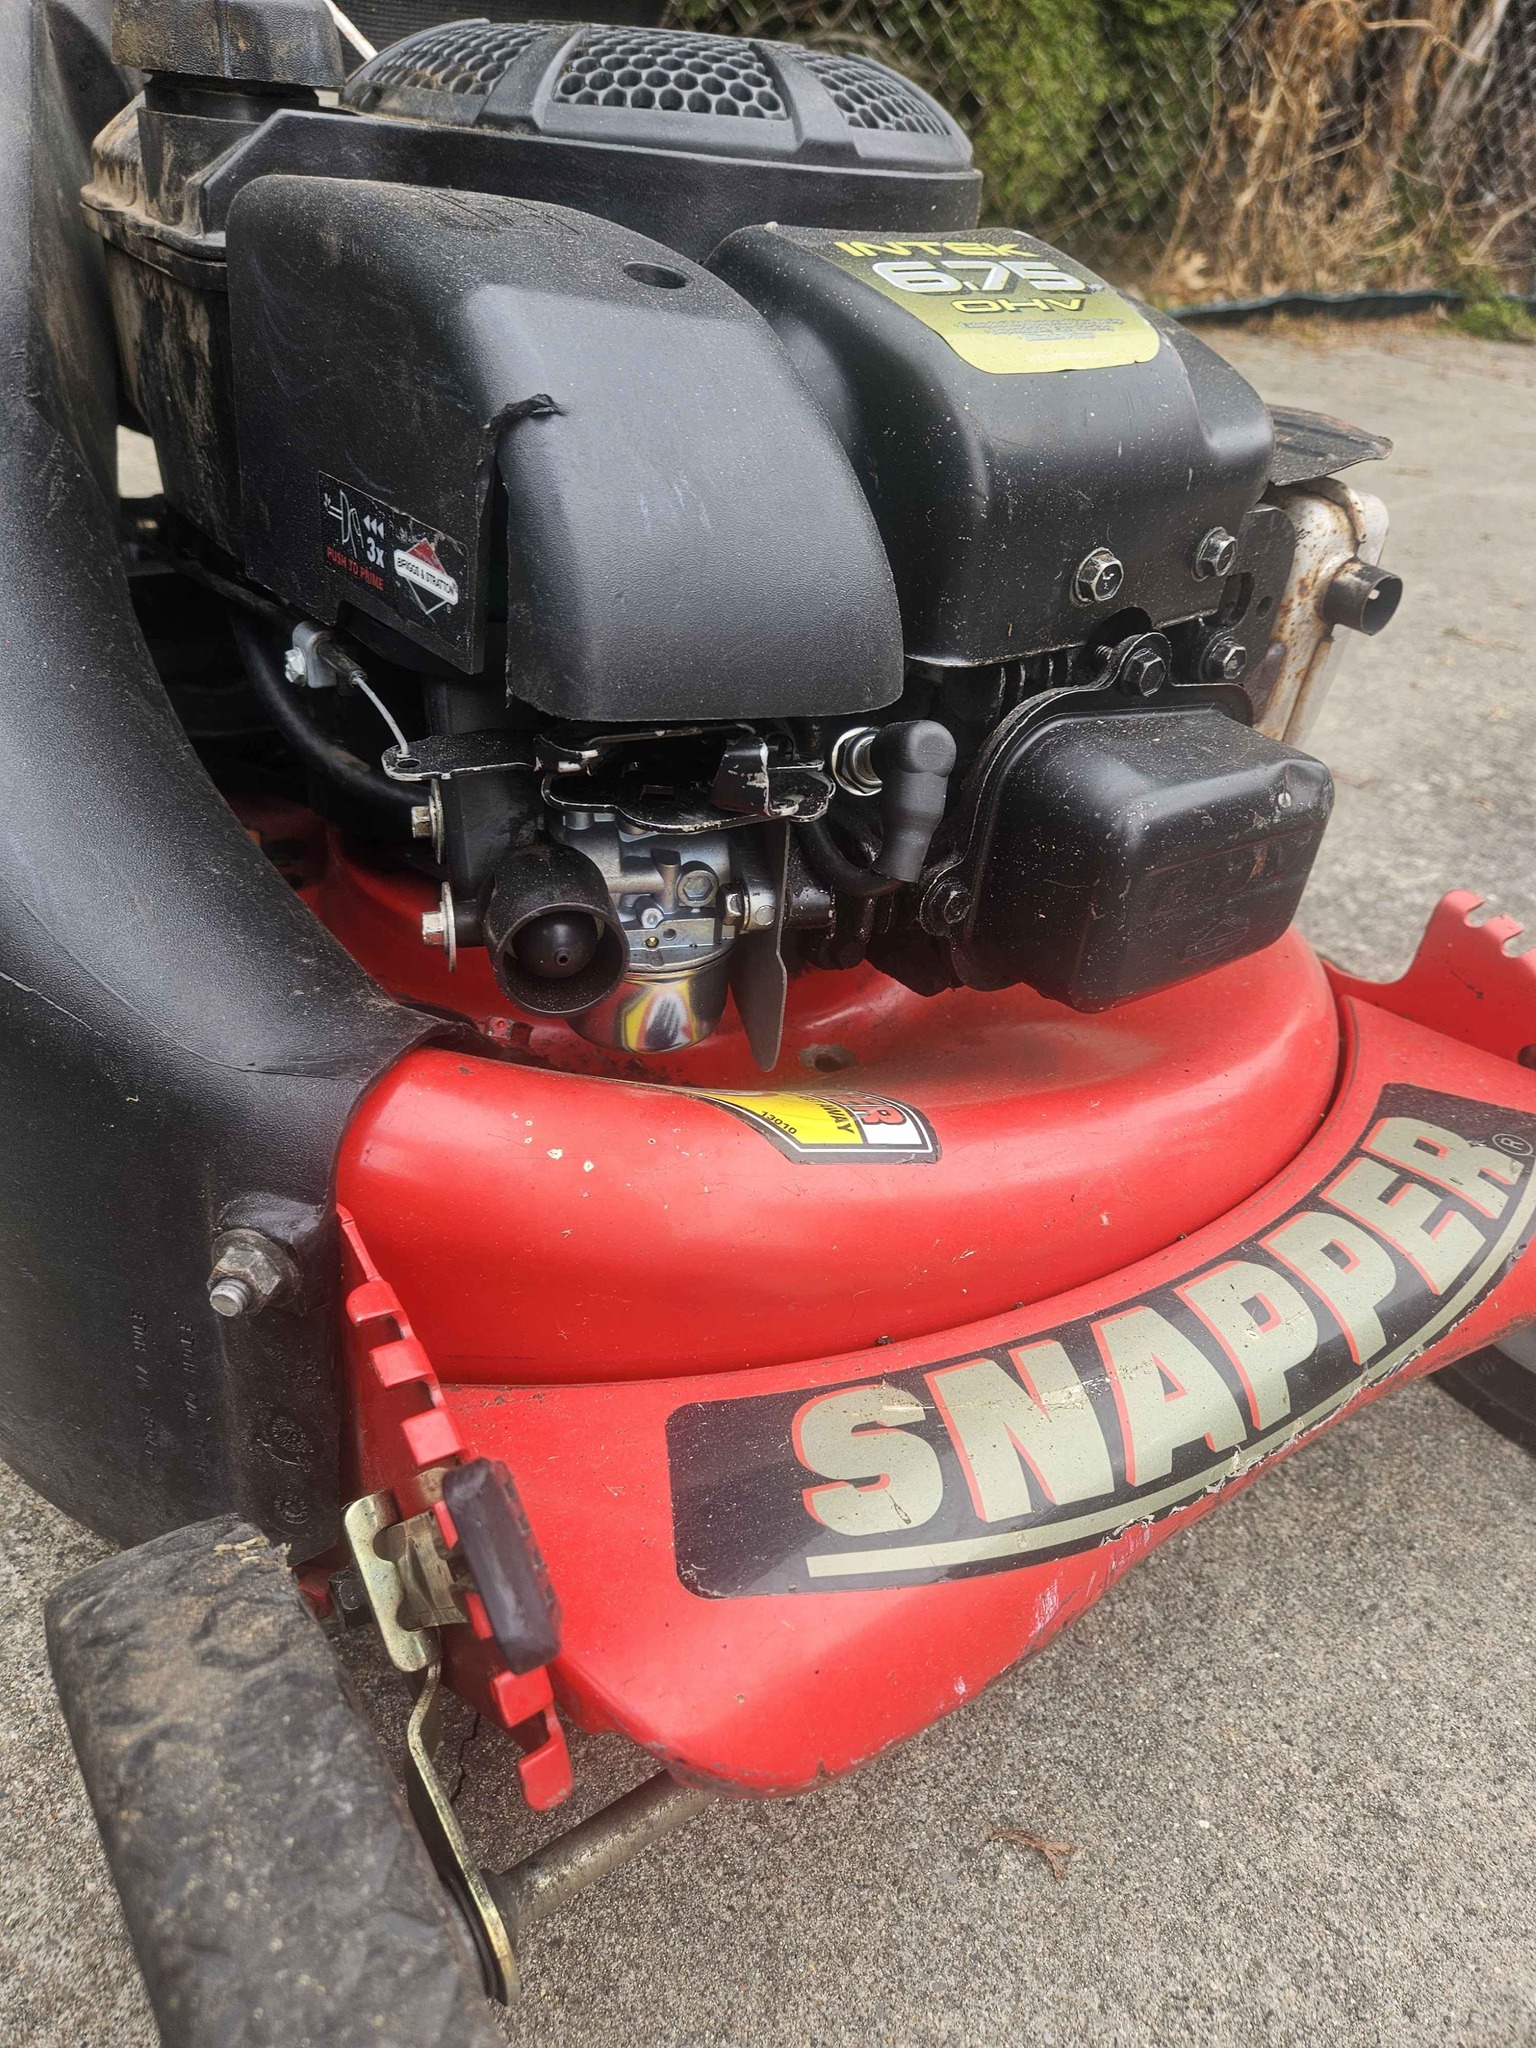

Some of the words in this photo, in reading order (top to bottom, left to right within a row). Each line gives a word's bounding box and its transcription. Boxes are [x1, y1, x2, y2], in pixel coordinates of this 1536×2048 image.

[834, 241, 1040, 257] INTEK
[872, 260, 1087, 293] 6.75
[951, 298, 1083, 313] OHV
[326, 545, 347, 568] PUSH
[348, 558, 359, 576] TO
[360, 565, 384, 591] PRIME
[792, 1115, 1524, 1537] SNAPPER
